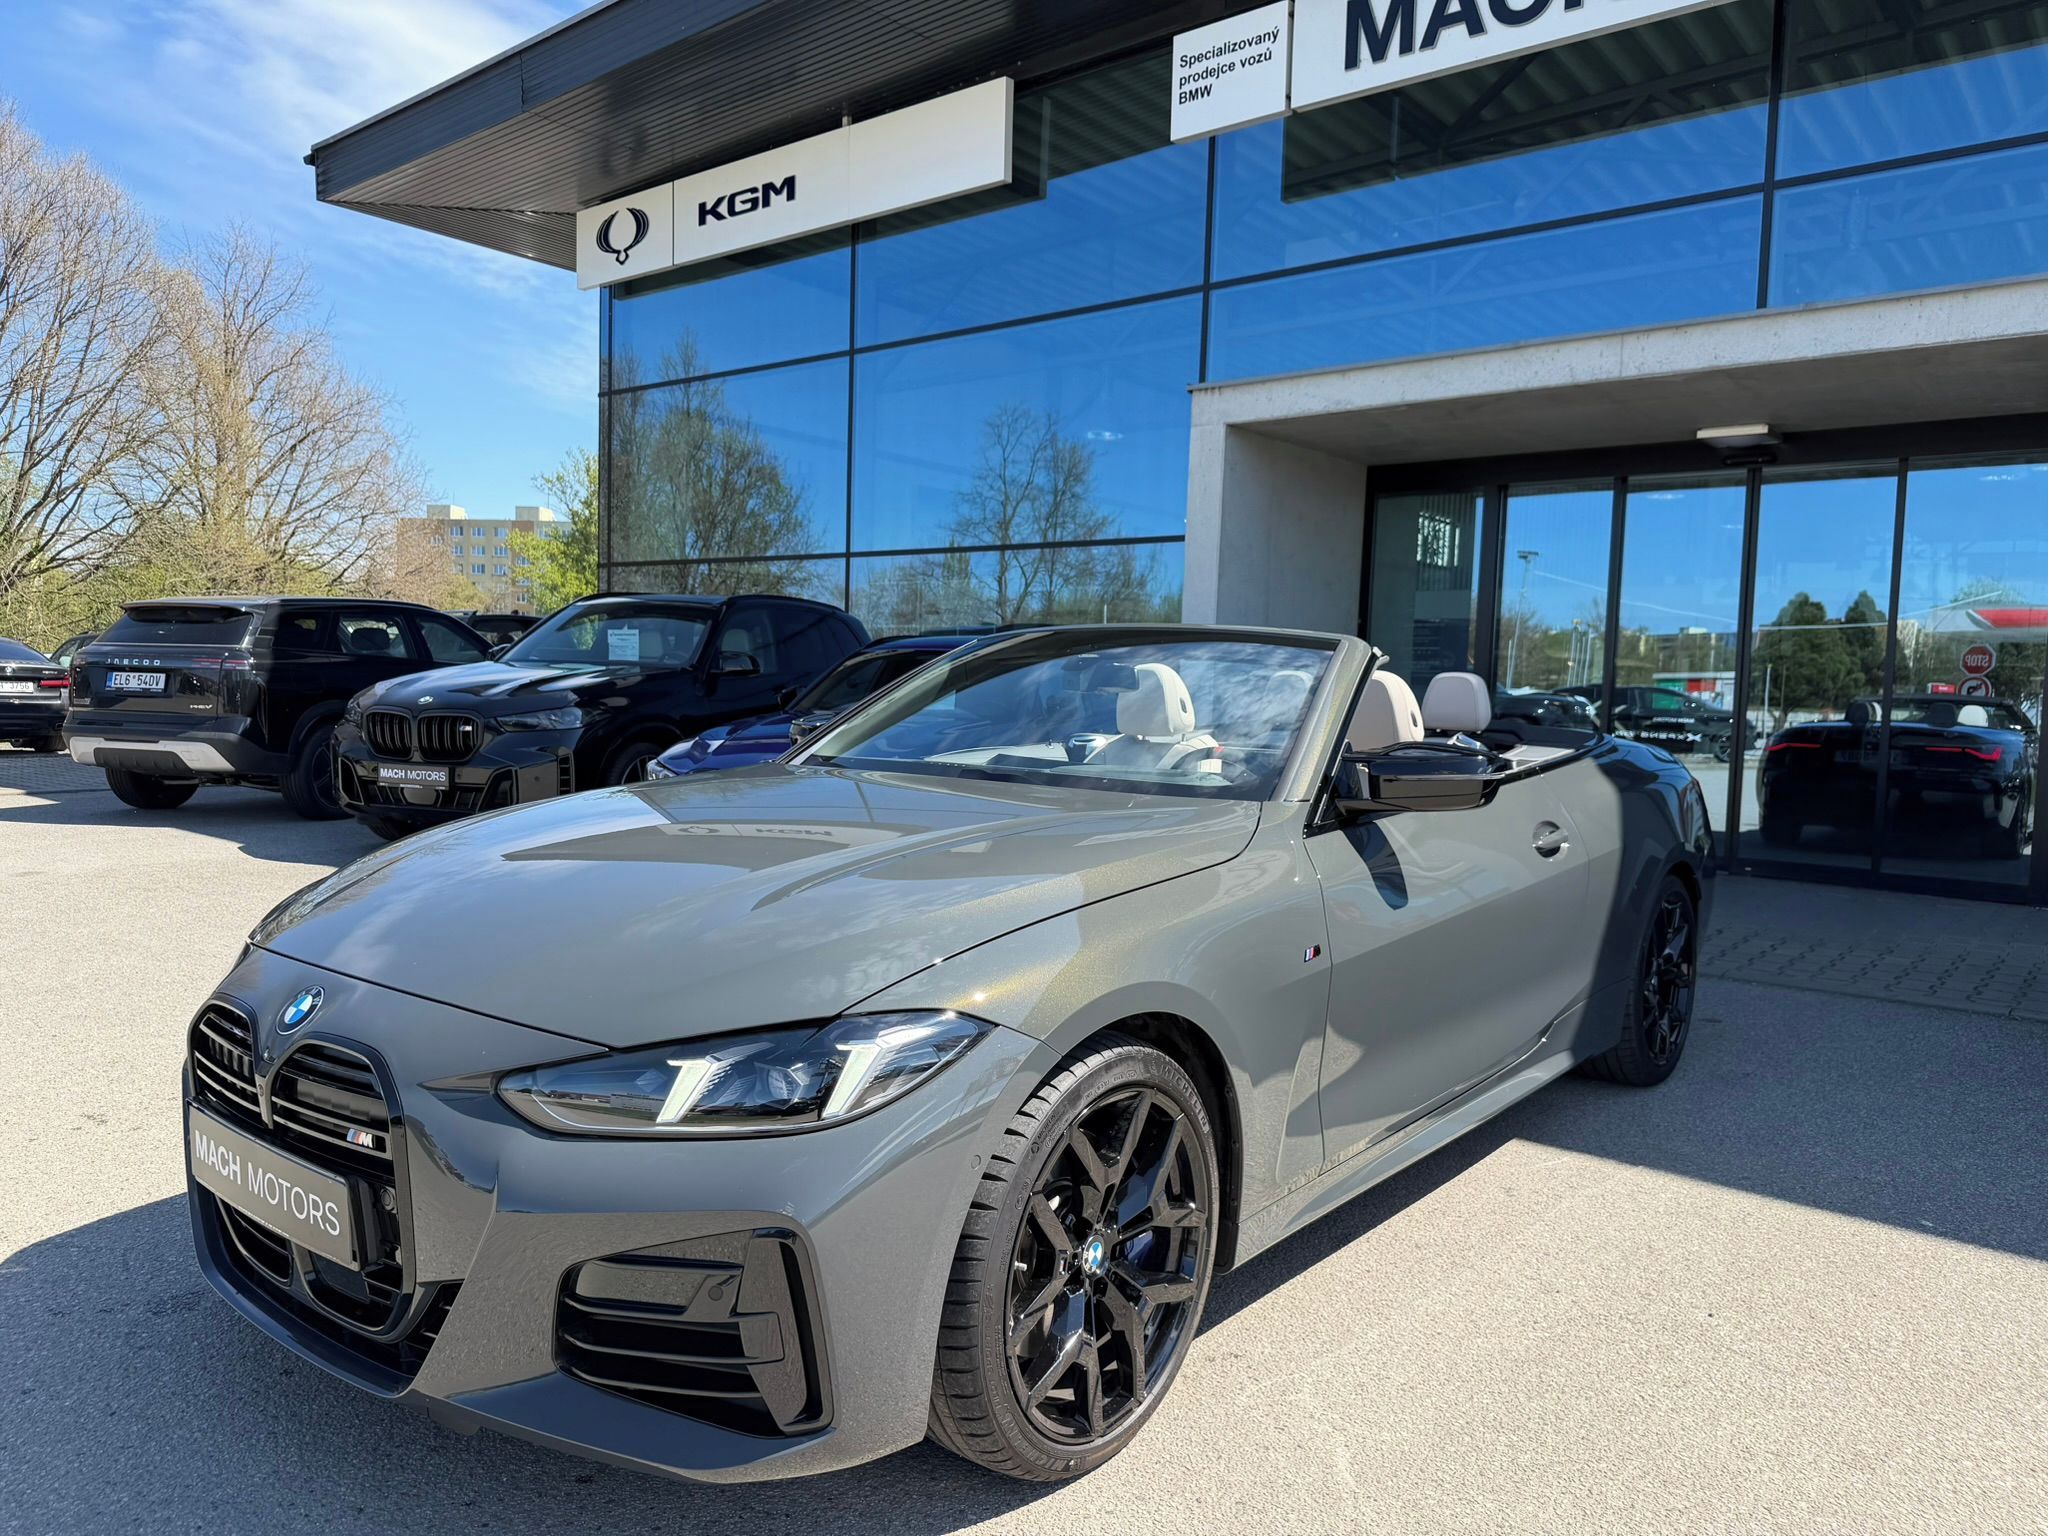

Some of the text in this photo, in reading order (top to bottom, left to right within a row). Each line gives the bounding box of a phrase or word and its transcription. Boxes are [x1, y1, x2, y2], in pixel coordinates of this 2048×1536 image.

[1179, 25, 1280, 69] Specializovaný
[1345, 0, 1585, 71] MA
[1179, 47, 1273, 90] prodejce vozů
[1178, 83, 1214, 106] BMW
[698, 174, 796, 228] KGM
[113, 673, 162, 688] EL6 54DV
[380, 768, 446, 782] MACH MOTORS
[195, 1130, 241, 1185] MACH
[247, 1161, 340, 1236] MOTORS
